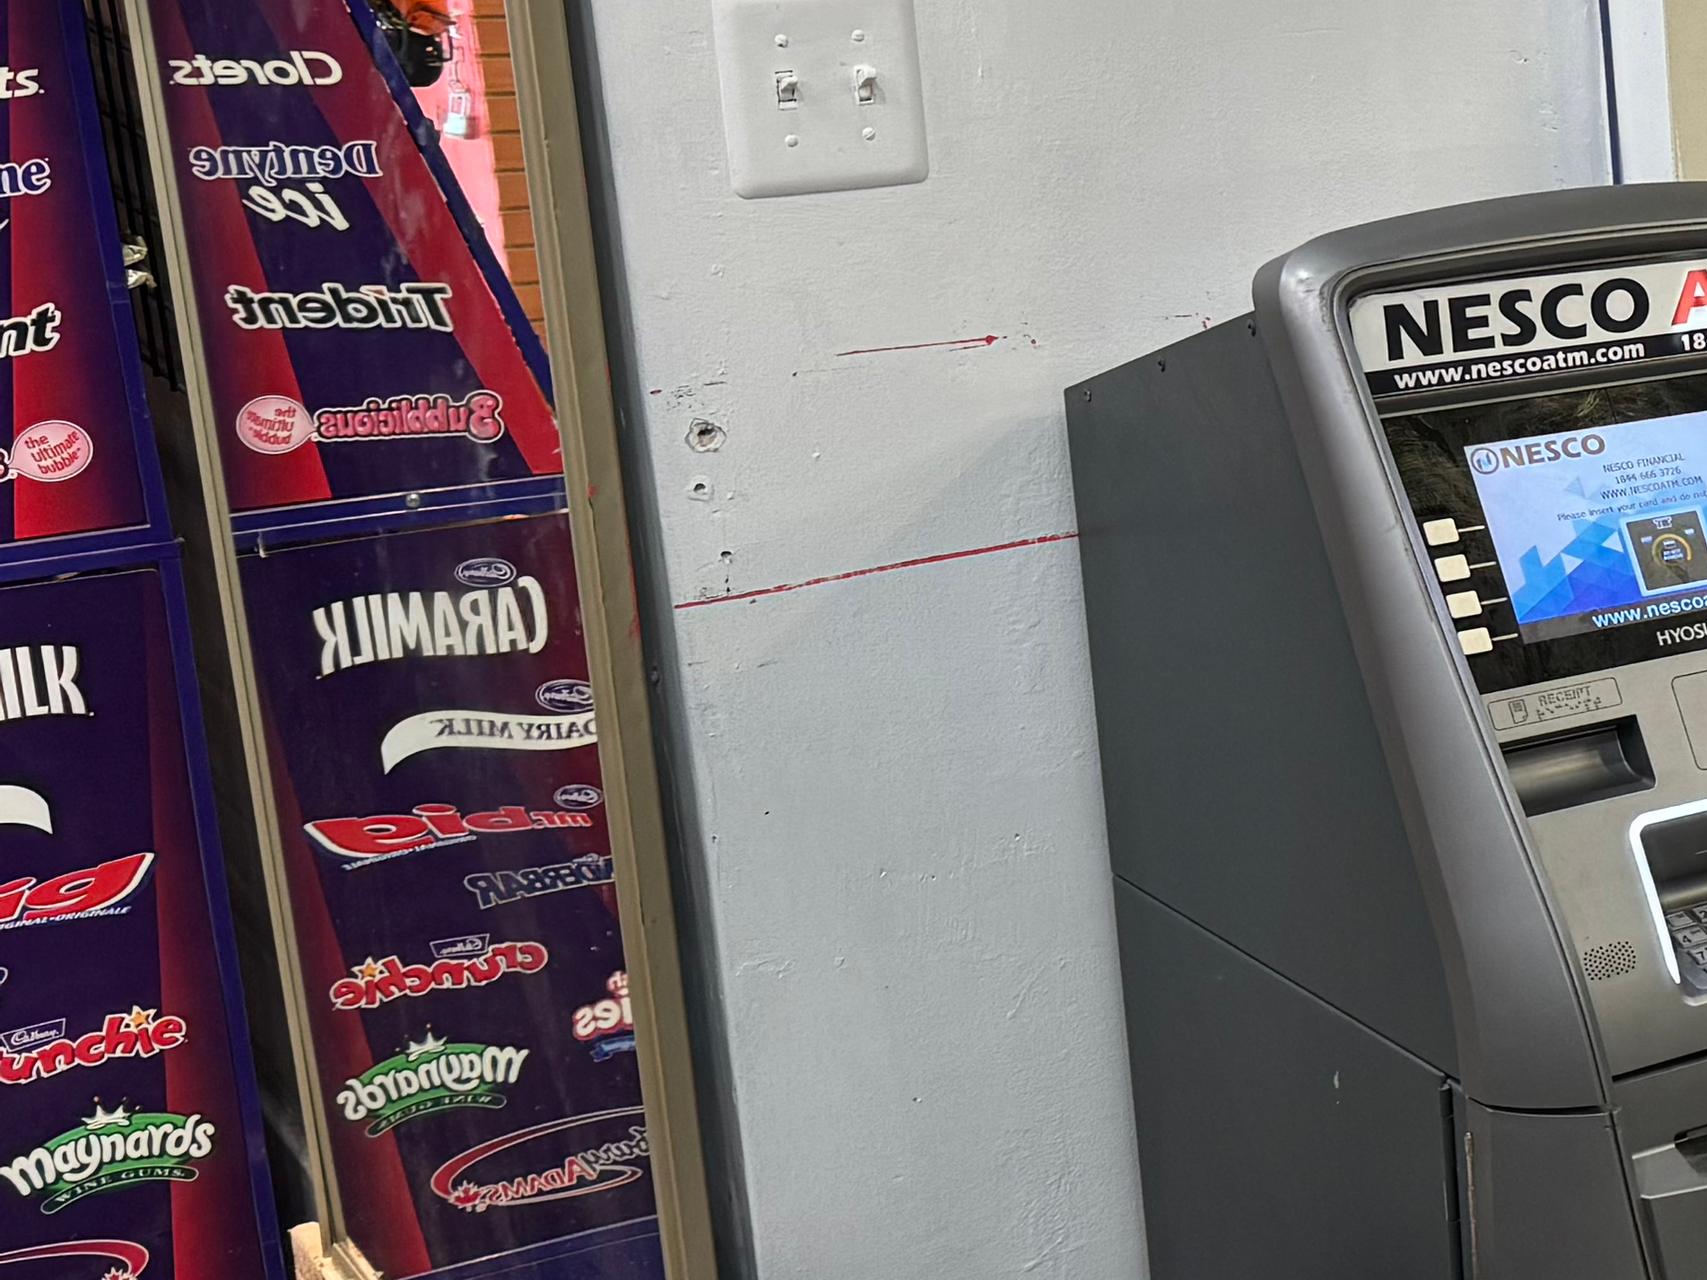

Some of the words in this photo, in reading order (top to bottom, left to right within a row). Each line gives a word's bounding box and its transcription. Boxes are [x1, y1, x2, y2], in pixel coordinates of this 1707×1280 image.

[1386, 277, 1650, 363] NESCO
[1393, 342, 1646, 389] www.nescoatm.com
[24, 433, 51, 451] the
[31, 429, 81, 463] ultimate
[1499, 433, 1606, 469] NESCO
[1602, 461, 1634, 474] NESCO
[1636, 453, 1685, 469] FINANCIAL
[1658, 466, 1682, 478] 3726
[1600, 475, 1703, 500] WWW.NESCOATM.COM
[1537, 685, 1593, 708] RECEIPT
[55, 1177, 112, 1203] WINE
